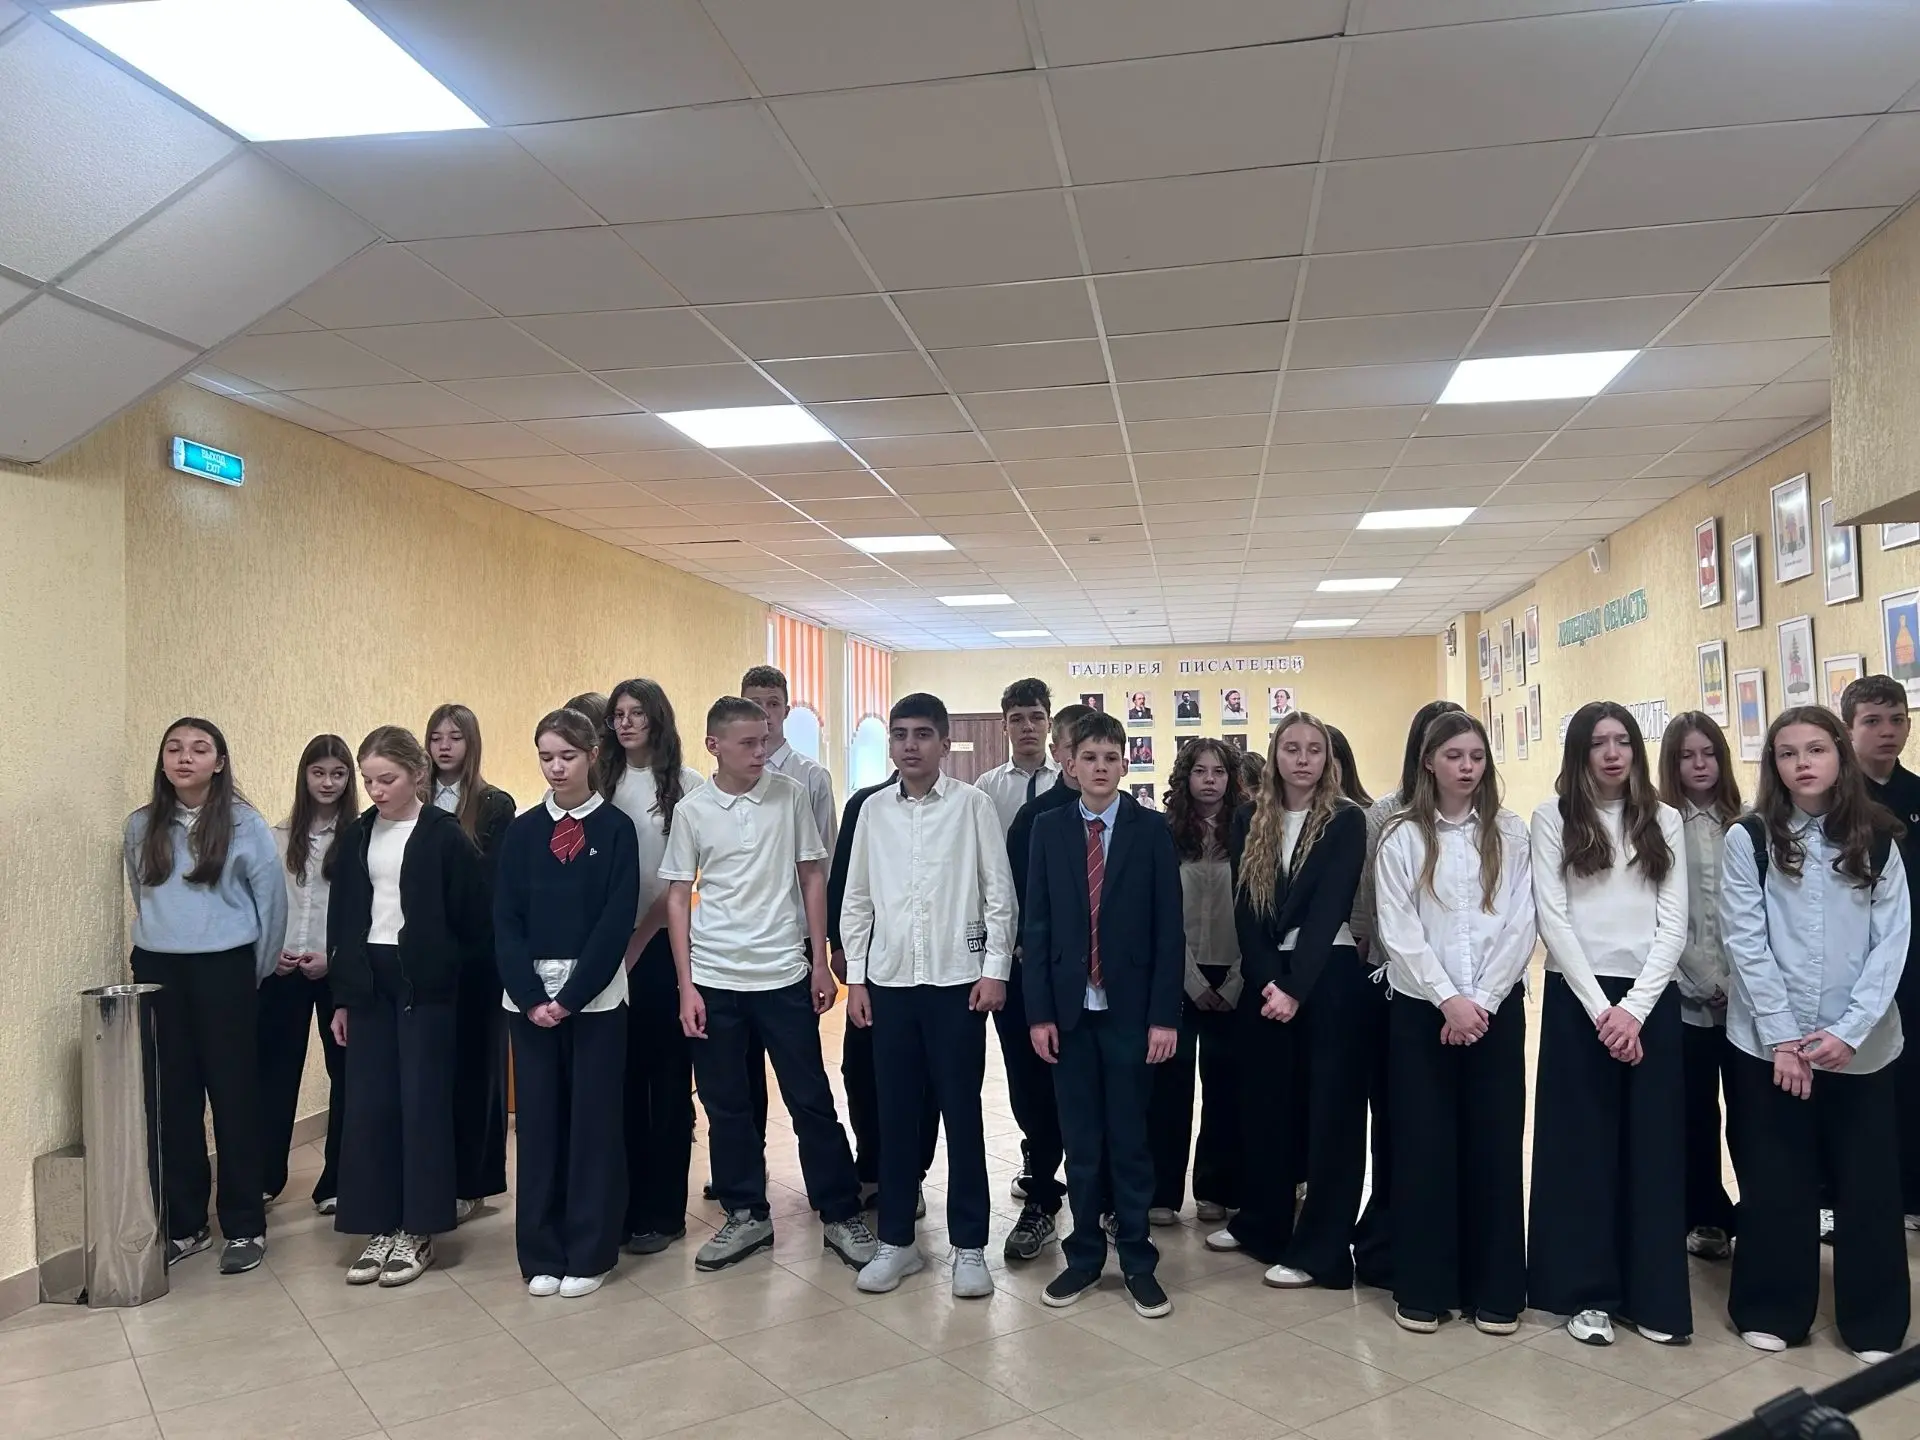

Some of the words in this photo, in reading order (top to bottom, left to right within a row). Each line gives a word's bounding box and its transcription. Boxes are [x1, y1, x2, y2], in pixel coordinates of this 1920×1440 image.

[1603, 588, 1647, 631] ОБЛАСТЬ
[1072, 663, 1161, 676] ГАЛЕРЕЯ
[1180, 656, 1302, 673] ПИСАТЕЛЕЙ
